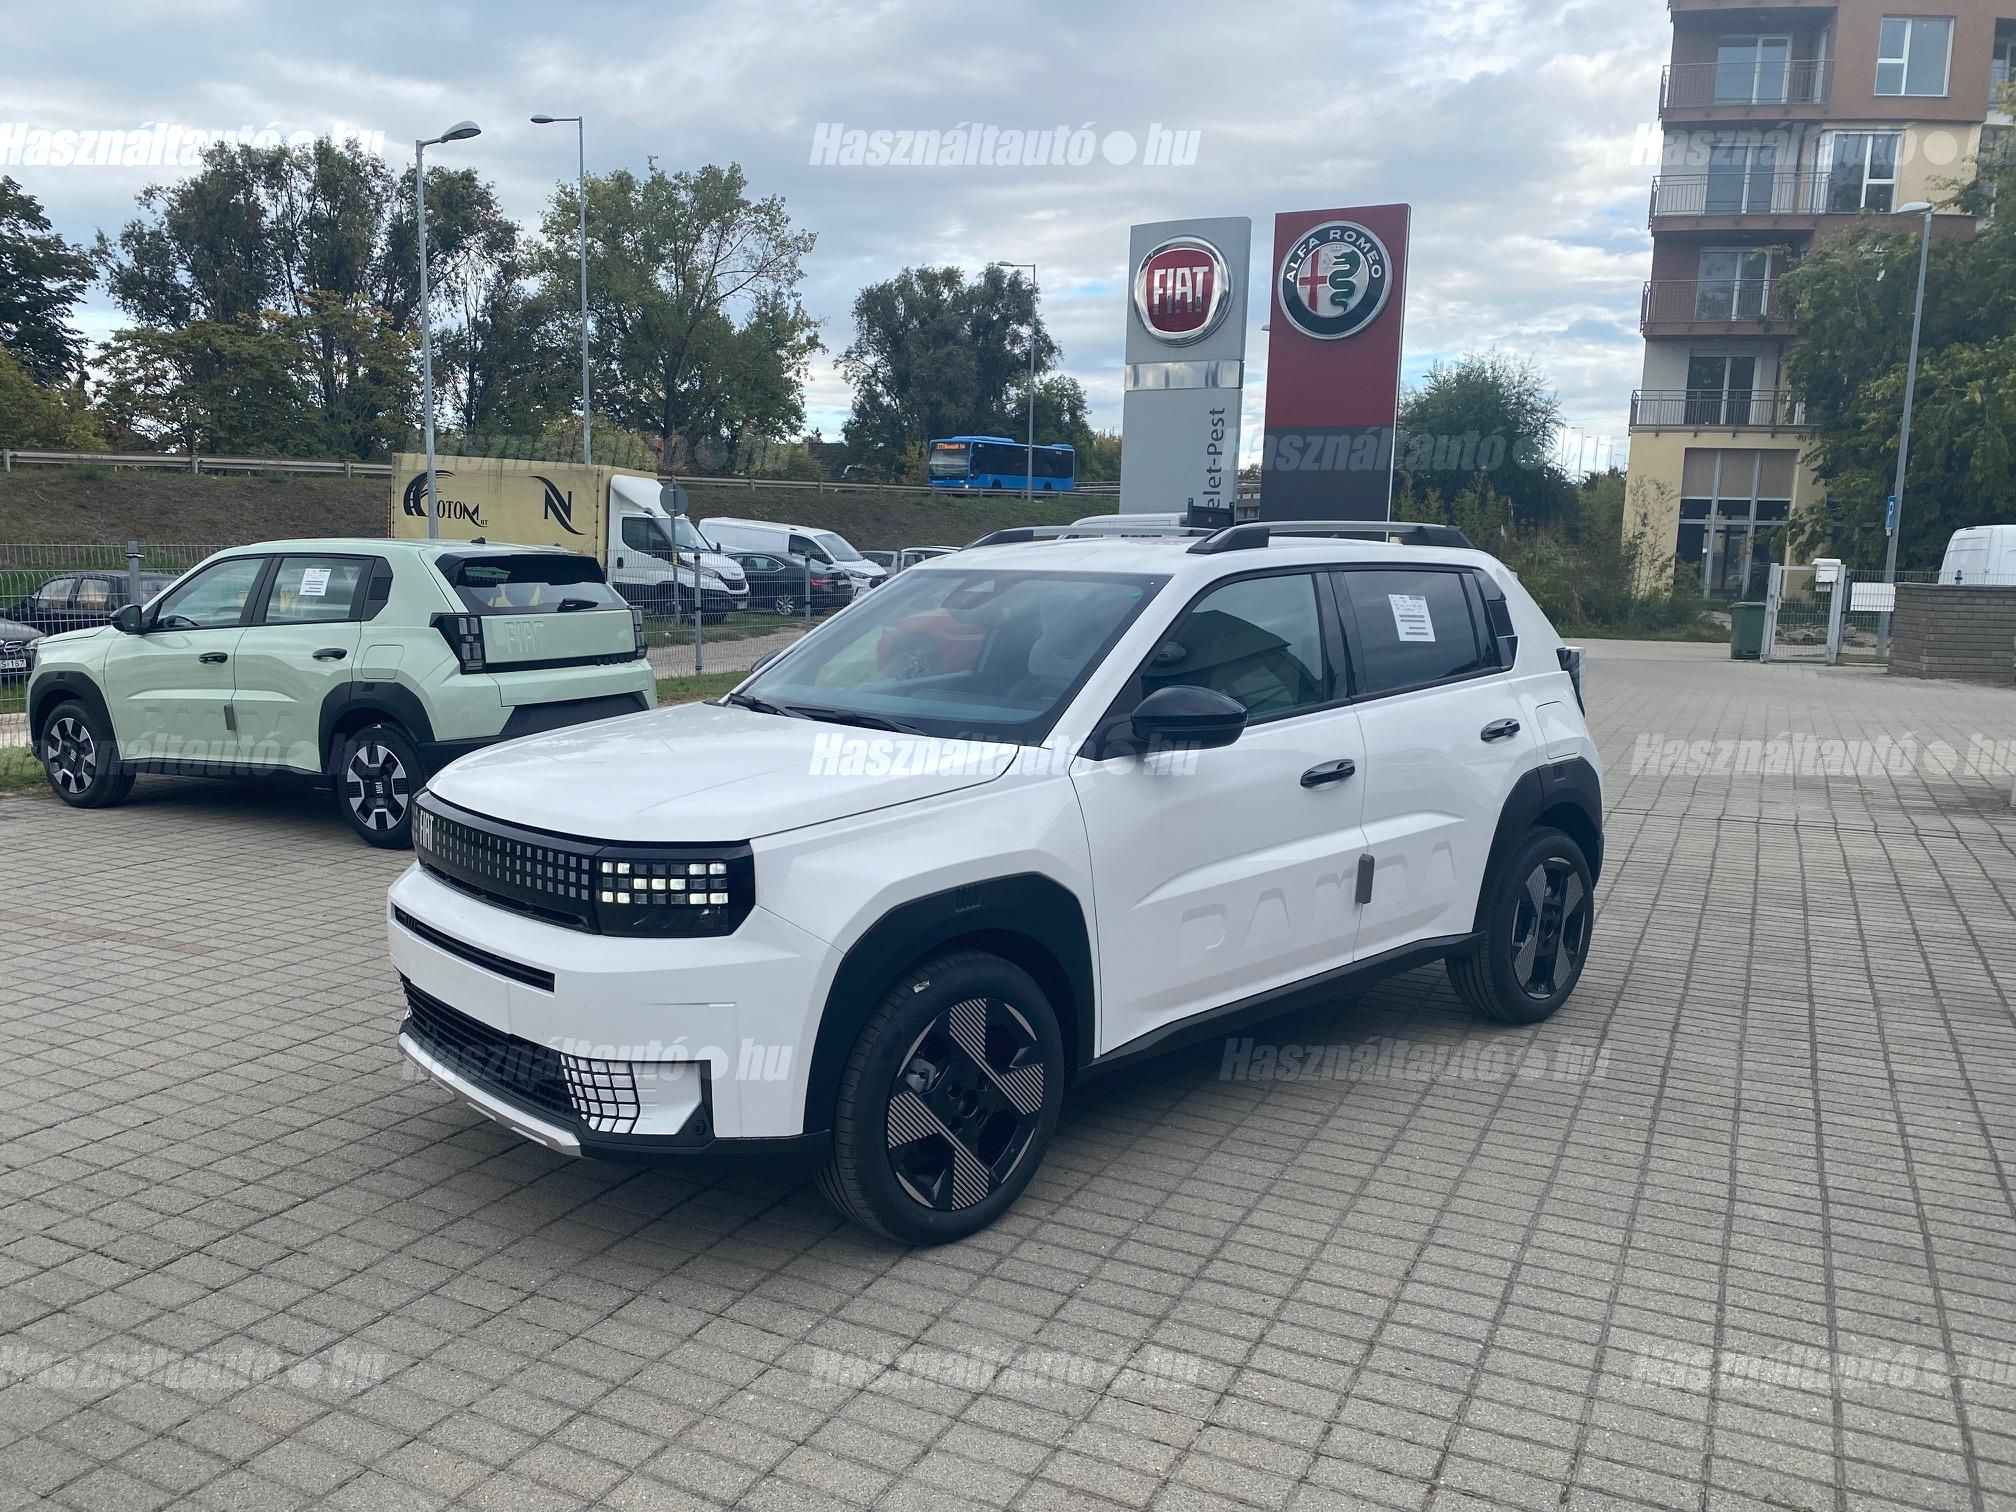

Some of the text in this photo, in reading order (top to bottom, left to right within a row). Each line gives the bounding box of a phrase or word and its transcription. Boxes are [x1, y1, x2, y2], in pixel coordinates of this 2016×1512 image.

[1285, 229, 1383, 284] ALFA ROMEO
[1153, 266, 1210, 315] FIAT
[503, 619, 545, 653] FIAT
[420, 809, 434, 852] FIAT
